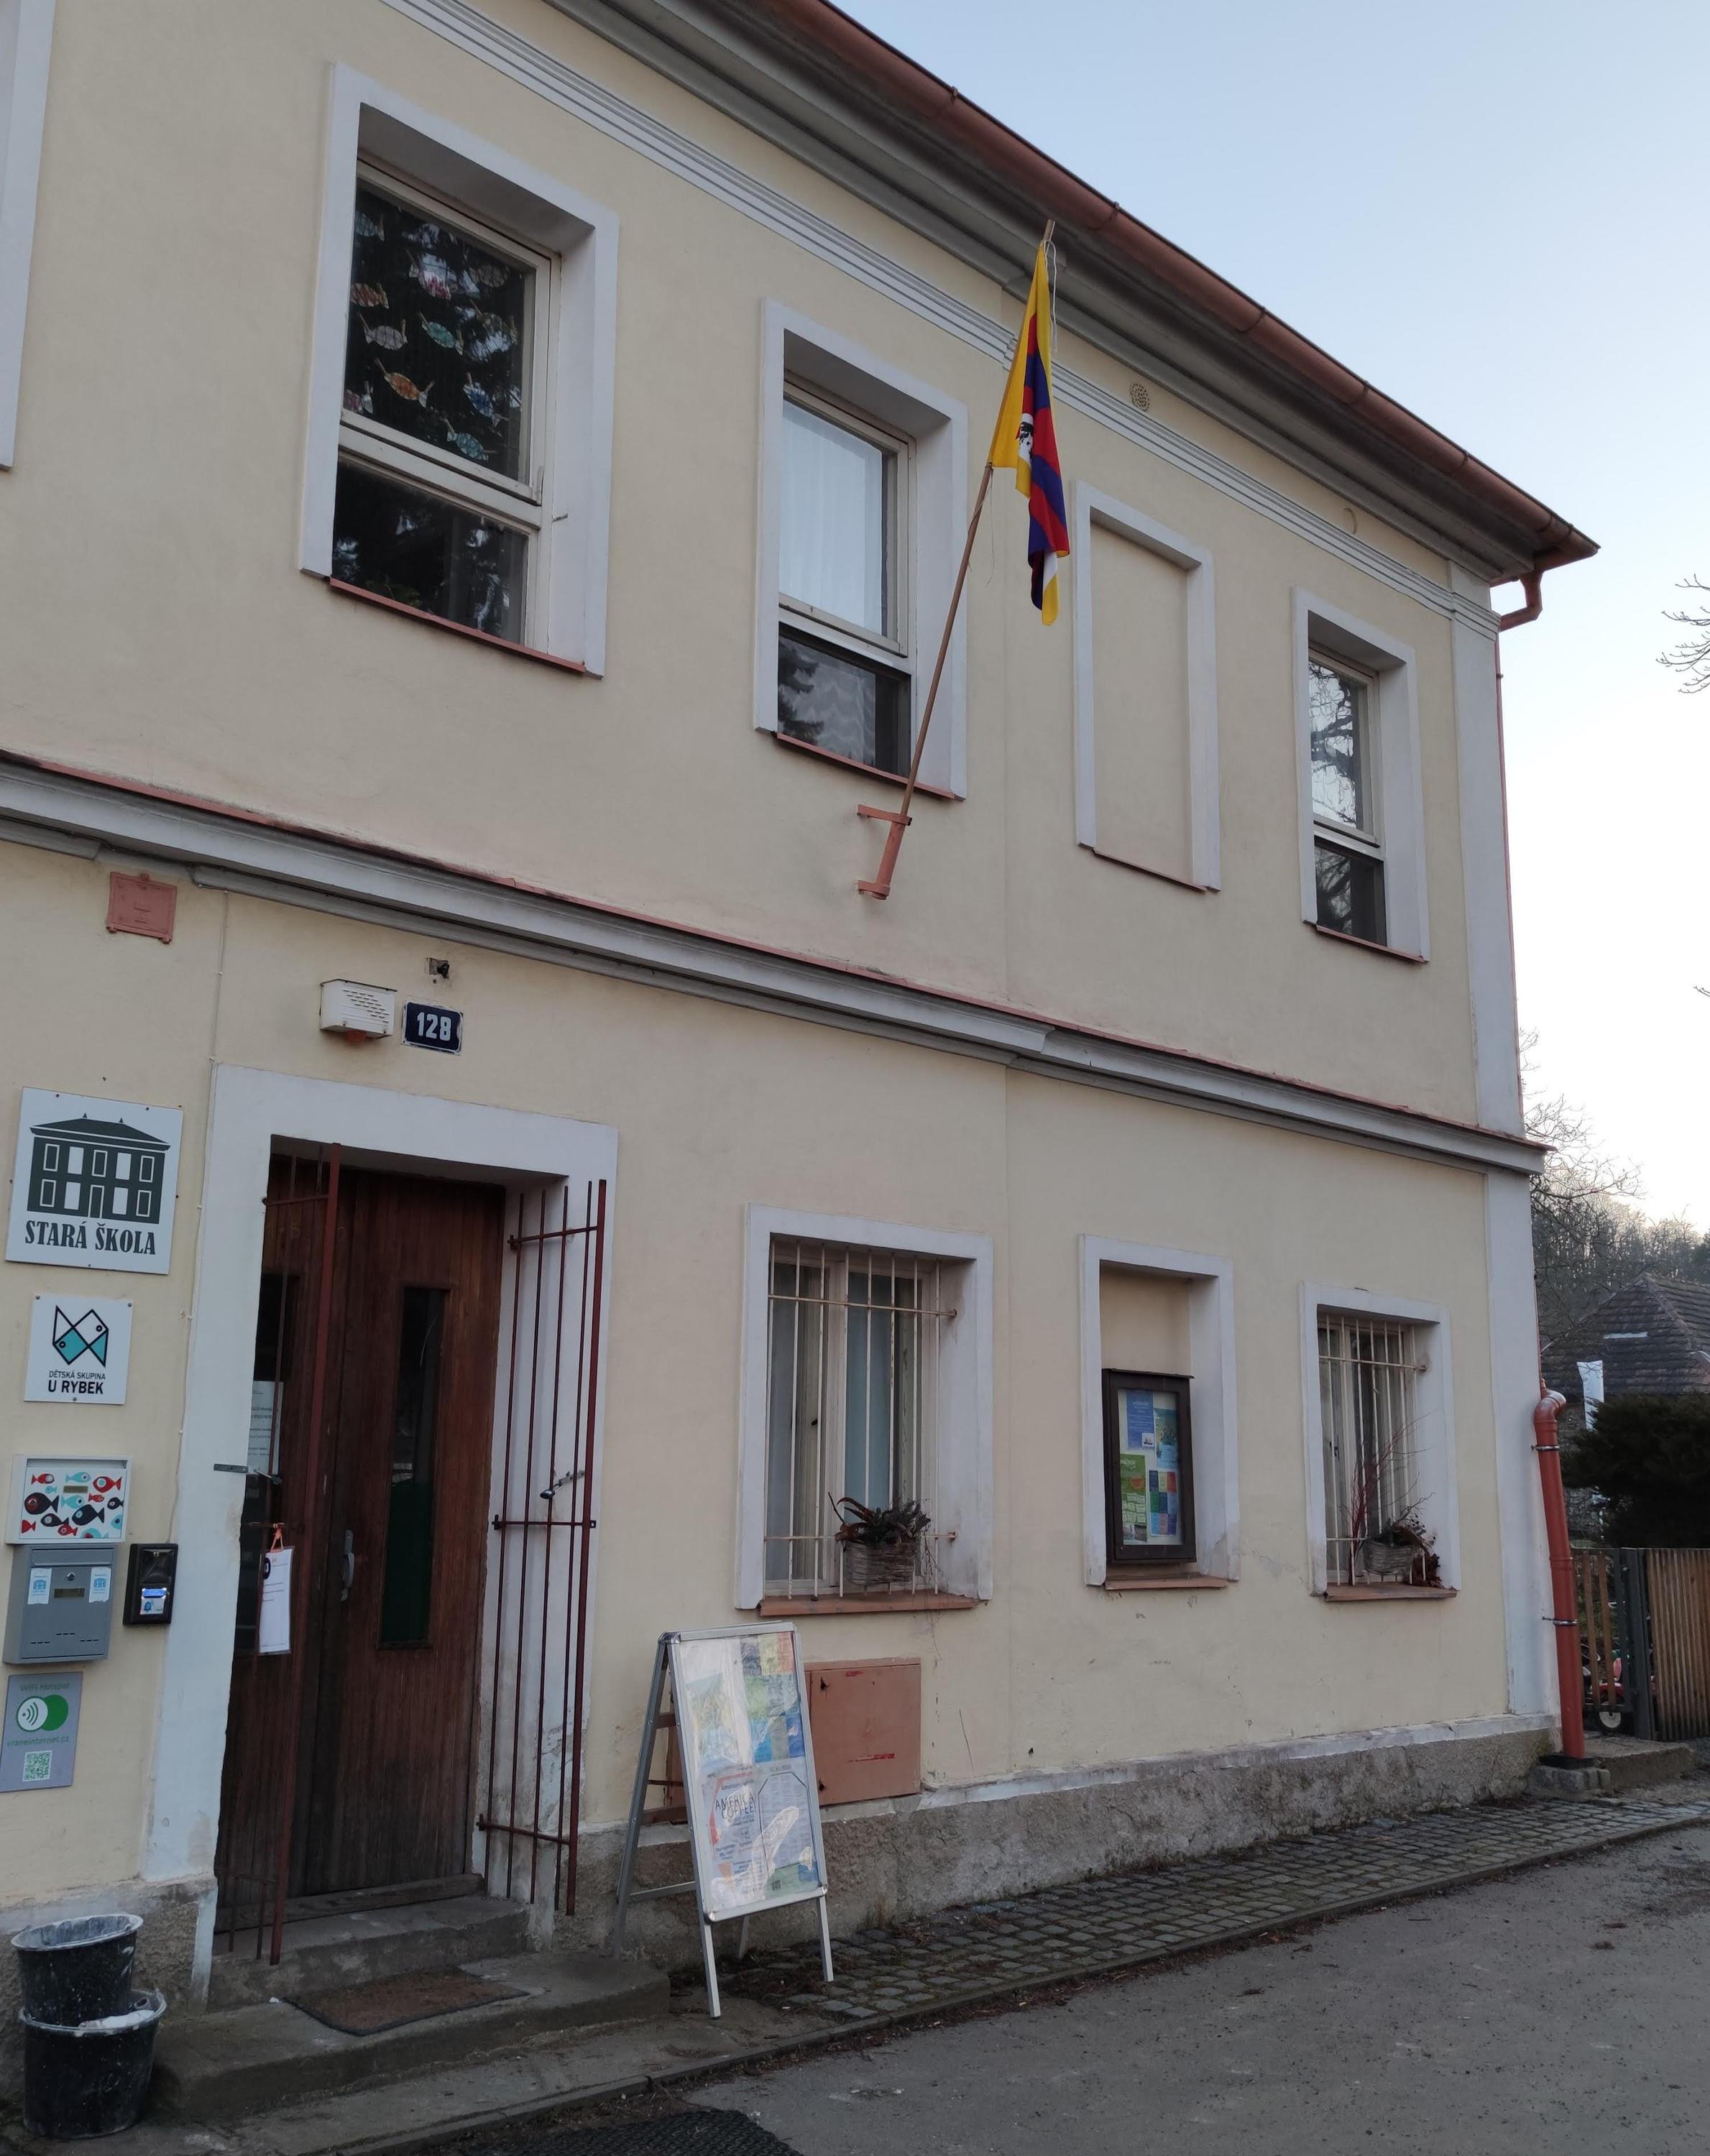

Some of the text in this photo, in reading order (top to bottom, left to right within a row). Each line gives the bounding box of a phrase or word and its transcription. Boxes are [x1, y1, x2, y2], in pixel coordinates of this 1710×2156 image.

[417, 1012, 451, 1041] 128
[24, 1220, 156, 1255] STARÁ ŠKOLA
[49, 1369, 106, 1381] DĚTSKÁ SKUPINA
[48, 1380, 104, 1395] U RYBEK
